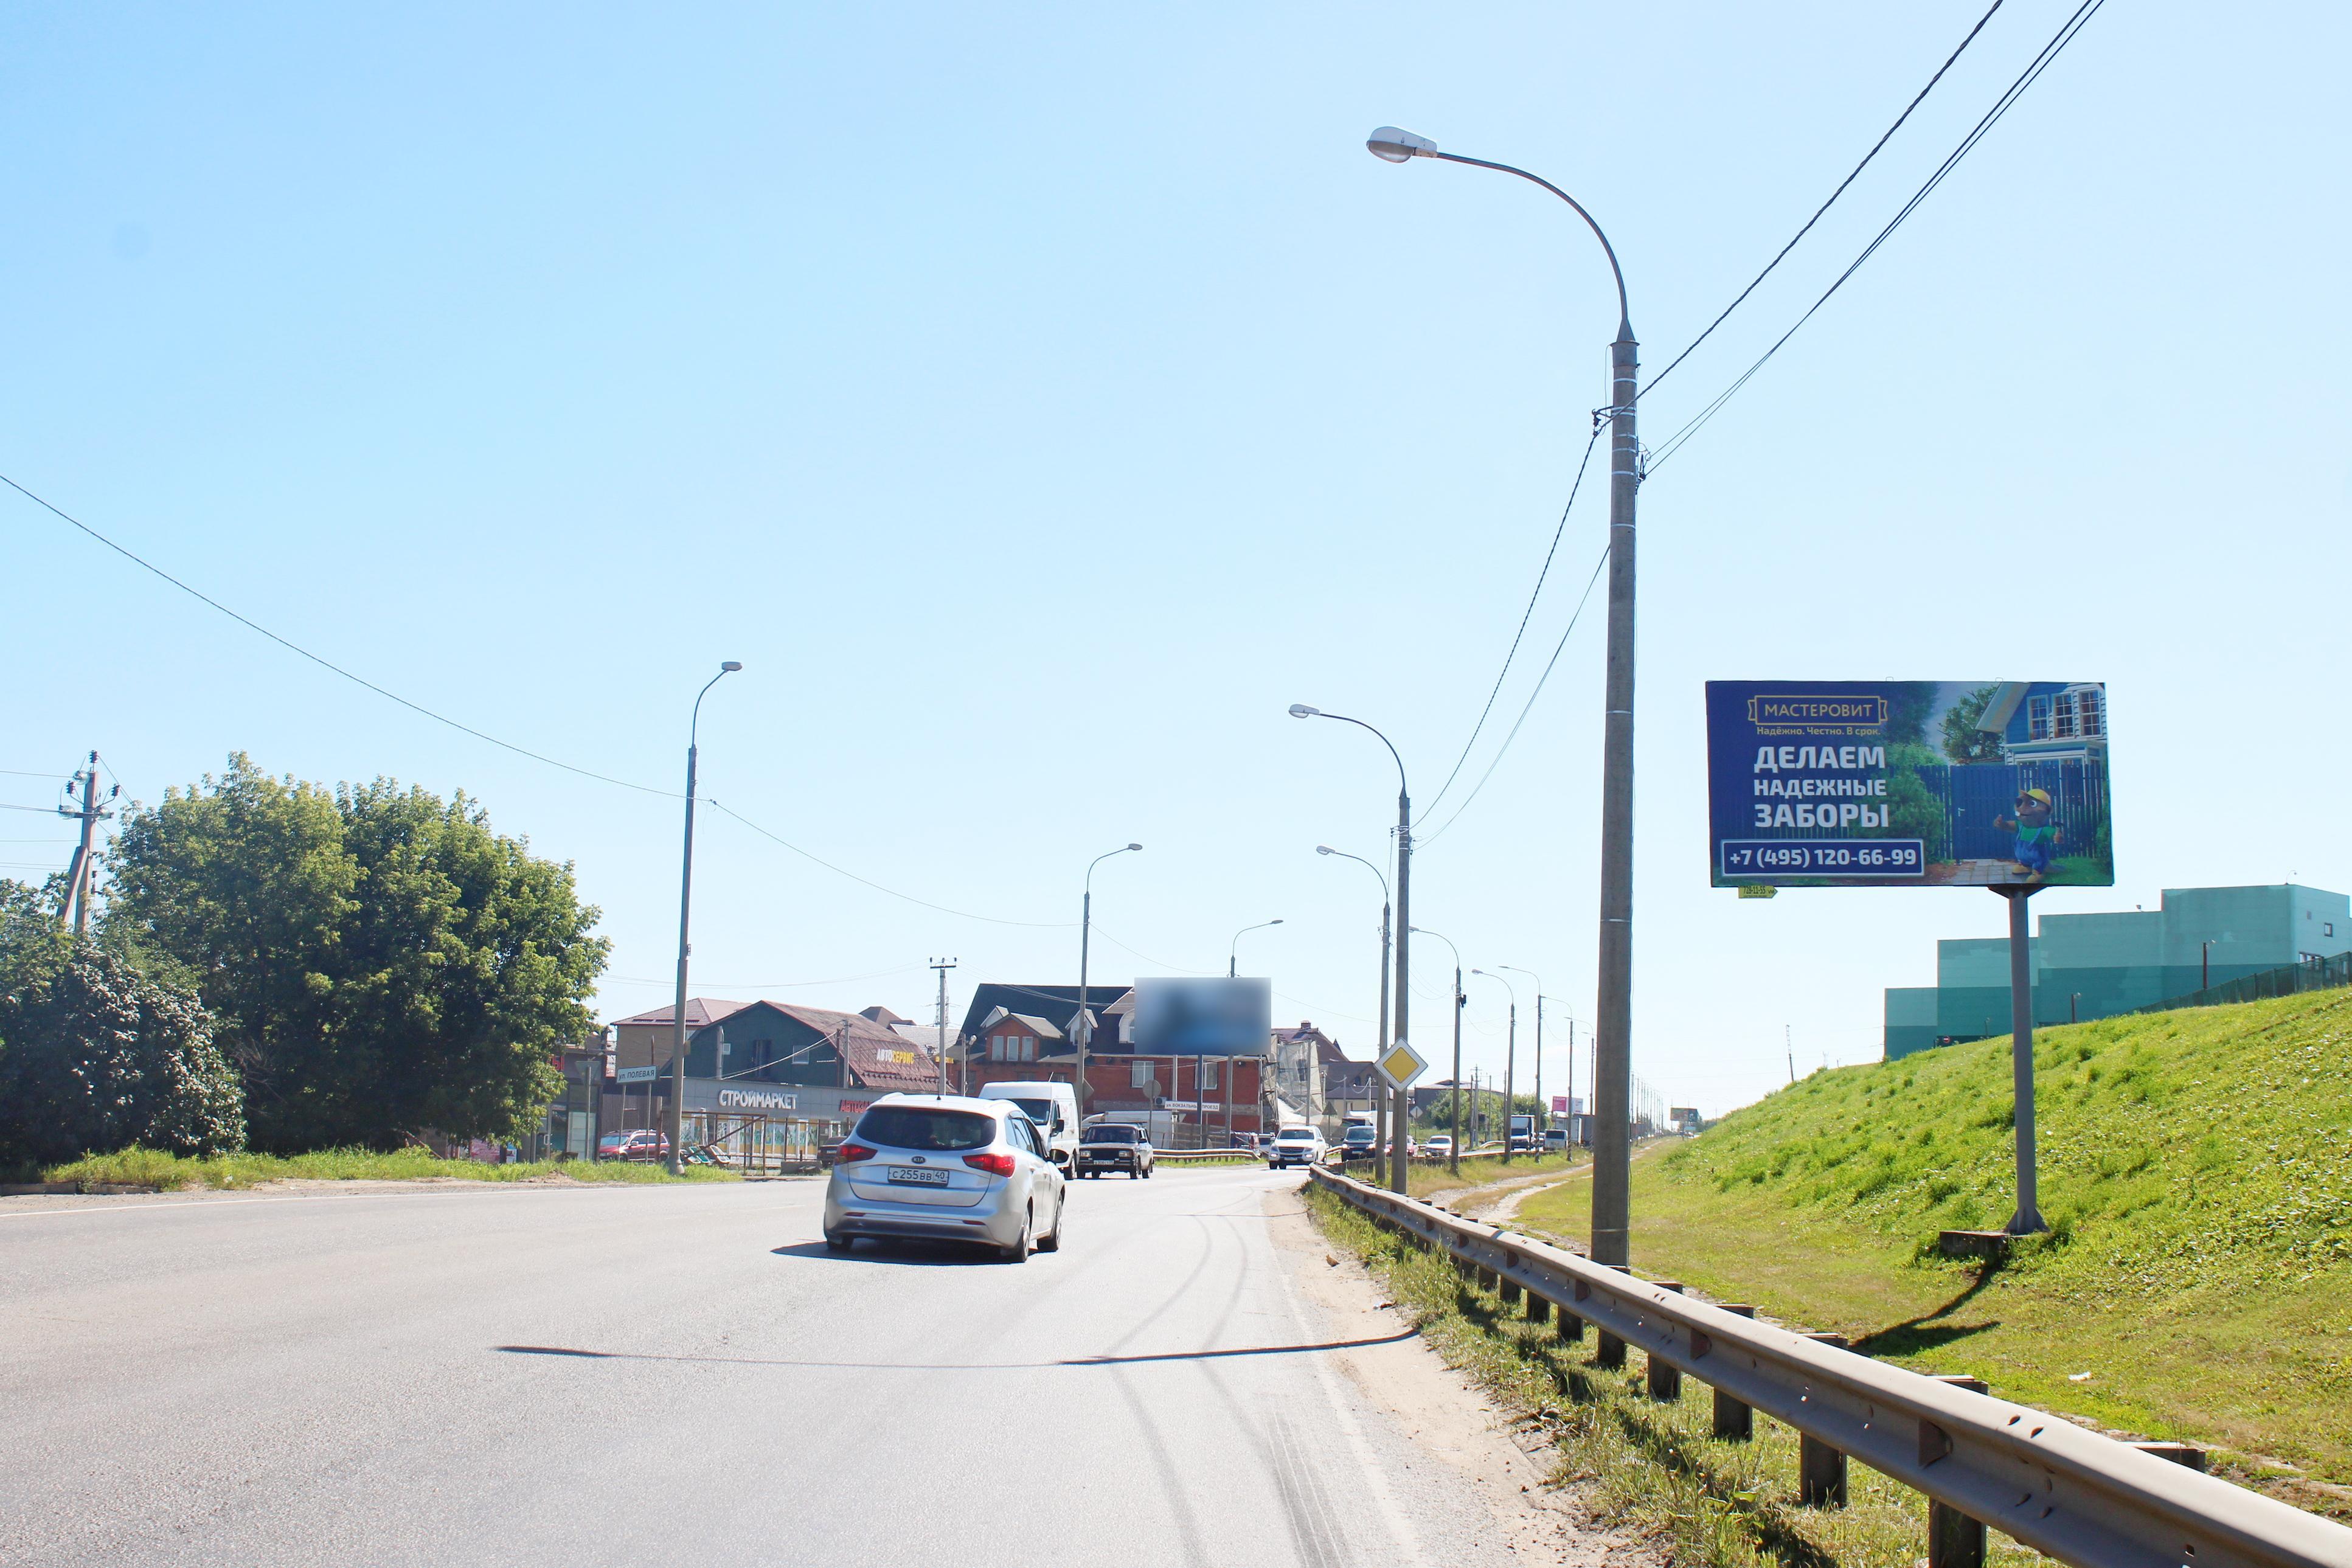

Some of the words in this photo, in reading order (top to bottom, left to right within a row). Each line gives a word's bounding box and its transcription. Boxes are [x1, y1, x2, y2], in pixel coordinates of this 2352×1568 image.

[1764, 704, 1873, 718] МАСТЕРОВИТ
[1757, 726, 1805, 737] Надёжно.
[1806, 727, 1844, 735] Честно.
[1846, 727, 1853, 735] В
[1754, 746, 1885, 774] ДЕЛАЕМ
[1754, 779, 1887, 799] НАДЕЖНЫЕ
[1754, 803, 1889, 828] ЗАБОРЫ
[1730, 849, 1752, 866] +7
[1756, 847, 1810, 869] (495)
[1814, 848, 1916, 866] 120-66-99
[876, 1048, 915, 1065] АВТОСЕРВИС
[627, 1070, 654, 1078] ПОЛЕВАЯ
[718, 1089, 798, 1110] СТРОЙМАРКЕТ
